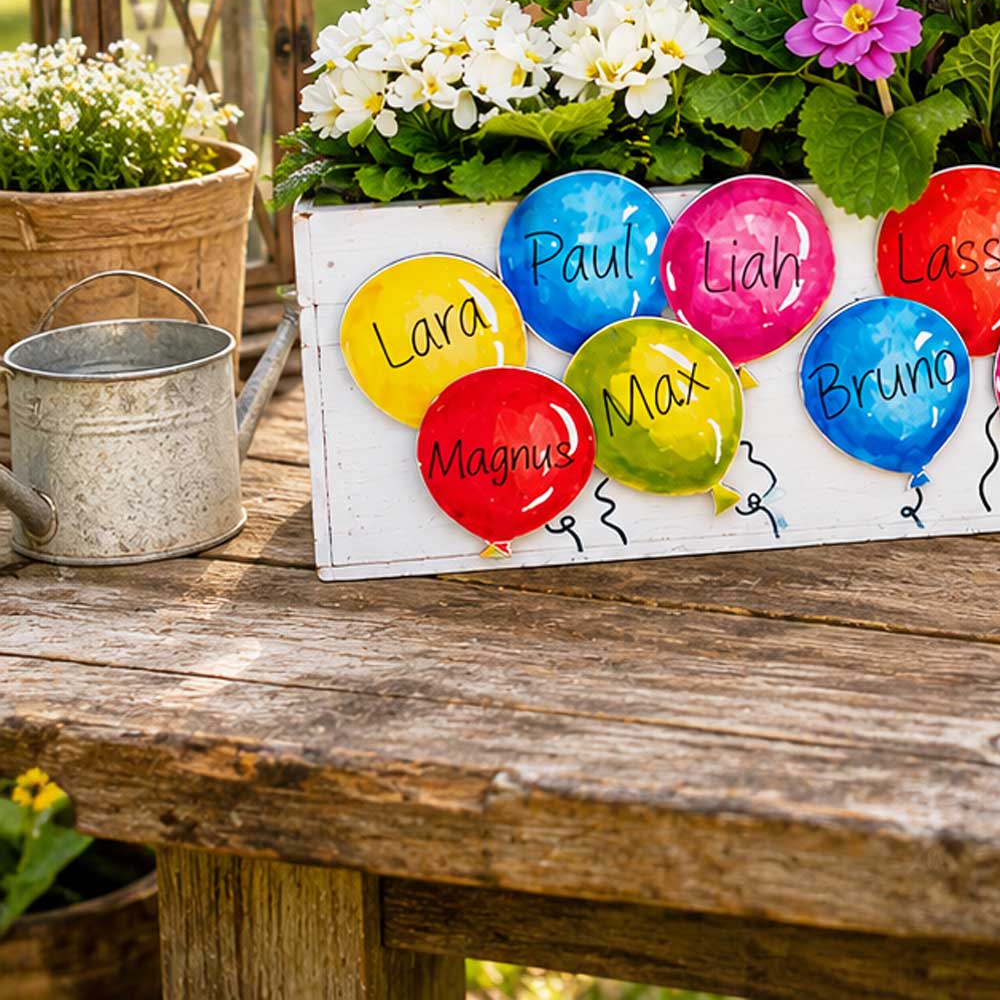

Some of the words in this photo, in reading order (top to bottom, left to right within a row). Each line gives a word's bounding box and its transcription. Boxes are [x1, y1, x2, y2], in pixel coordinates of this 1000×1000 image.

[523, 222, 634, 287] Paul
[703, 234, 802, 294] Liah
[371, 296, 490, 370] Lara
[601, 362, 711, 437] Max
[808, 349, 957, 421] Bruno
[427, 438, 576, 487] Magnus
